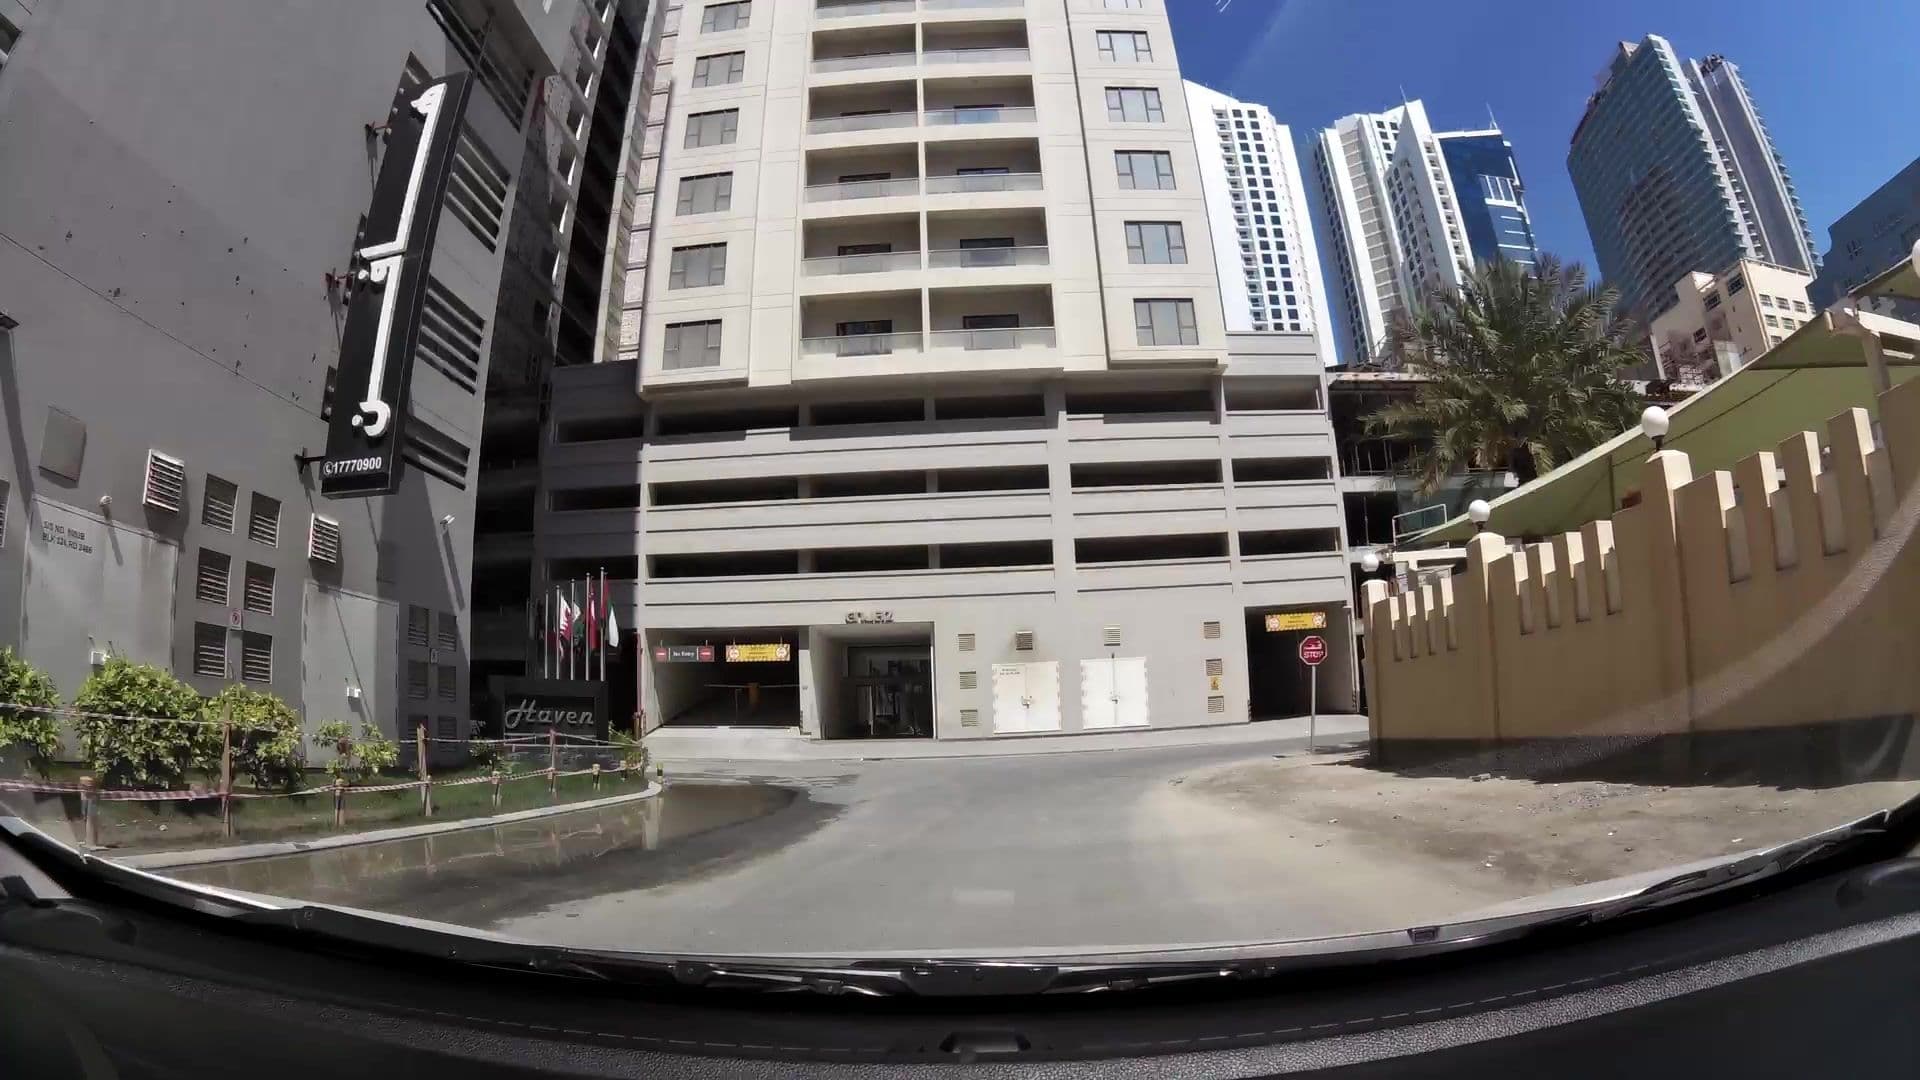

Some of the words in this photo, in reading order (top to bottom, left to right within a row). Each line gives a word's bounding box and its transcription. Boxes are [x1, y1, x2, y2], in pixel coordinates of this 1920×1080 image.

[334, 456, 382, 474] 17770900
[682, 651, 695, 659] Entry
[1303, 650, 1324, 659] STOP
[504, 699, 594, 729] Haven
